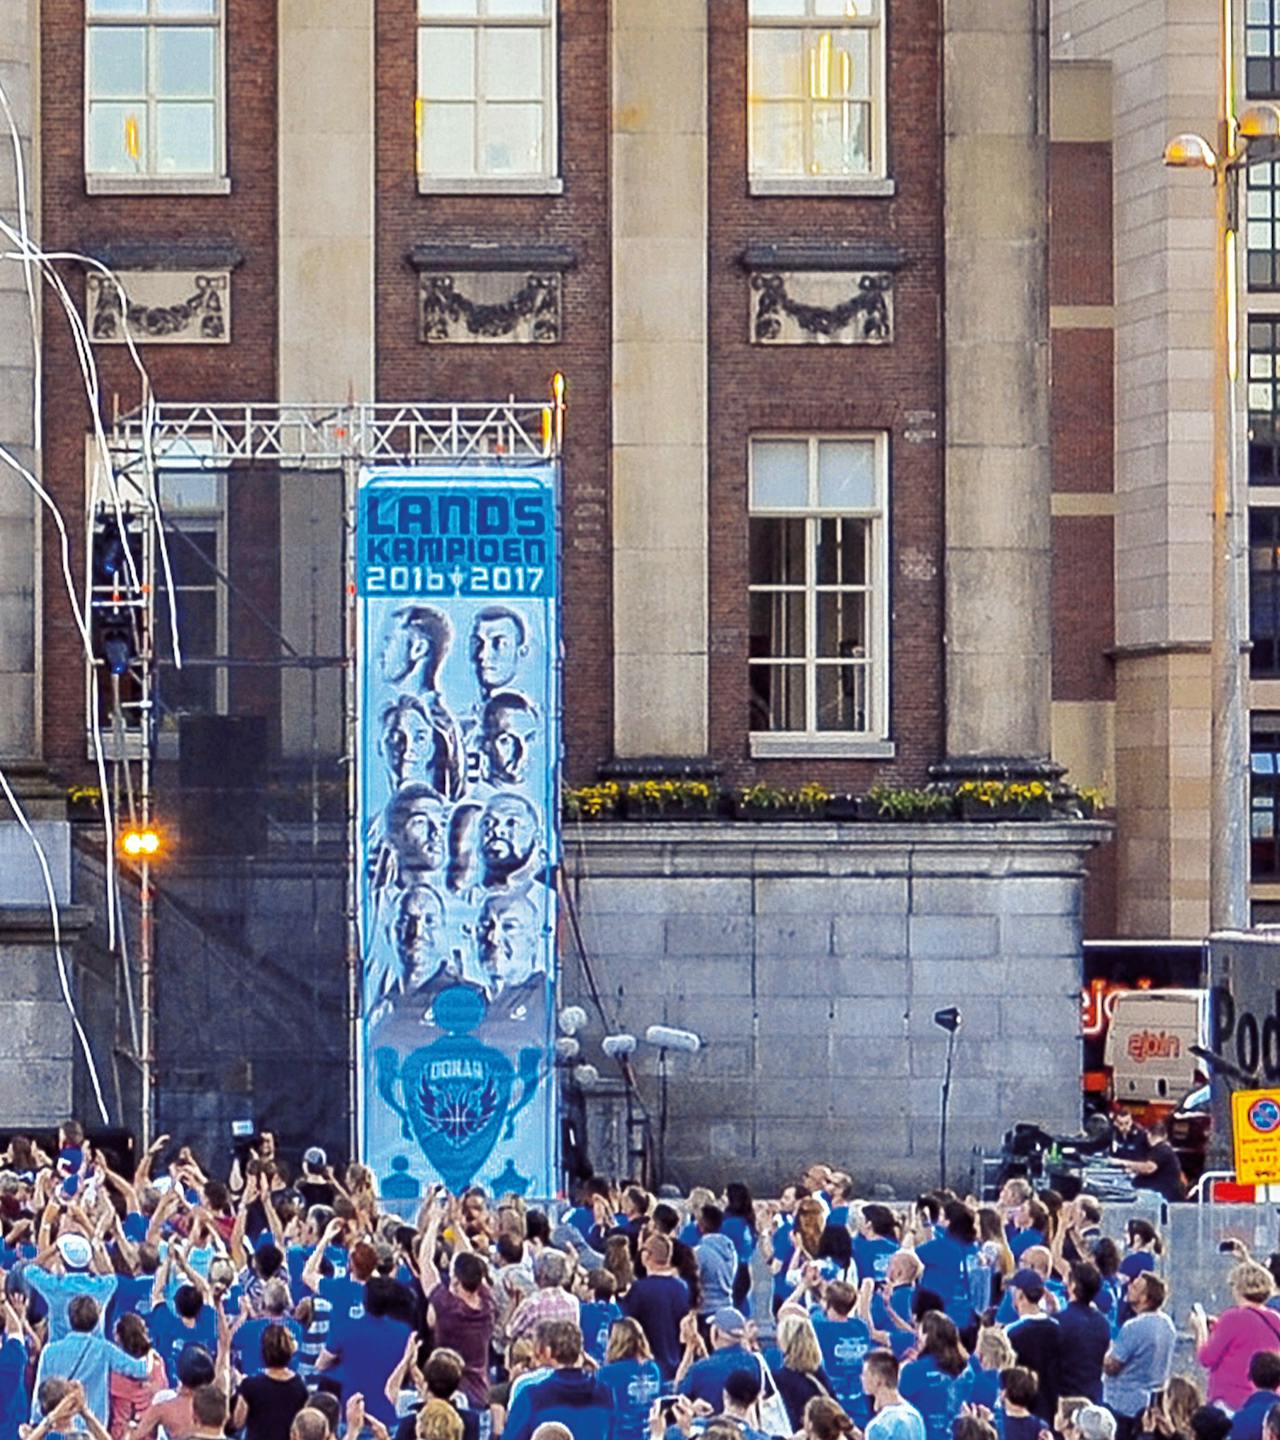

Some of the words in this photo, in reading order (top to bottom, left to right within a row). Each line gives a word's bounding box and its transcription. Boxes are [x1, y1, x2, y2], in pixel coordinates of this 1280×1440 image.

[367, 496, 545, 535] LANDS
[367, 537, 545, 563] KAMPIOEN
[366, 566, 443, 591] 2016
[471, 566, 543, 592] 2017
